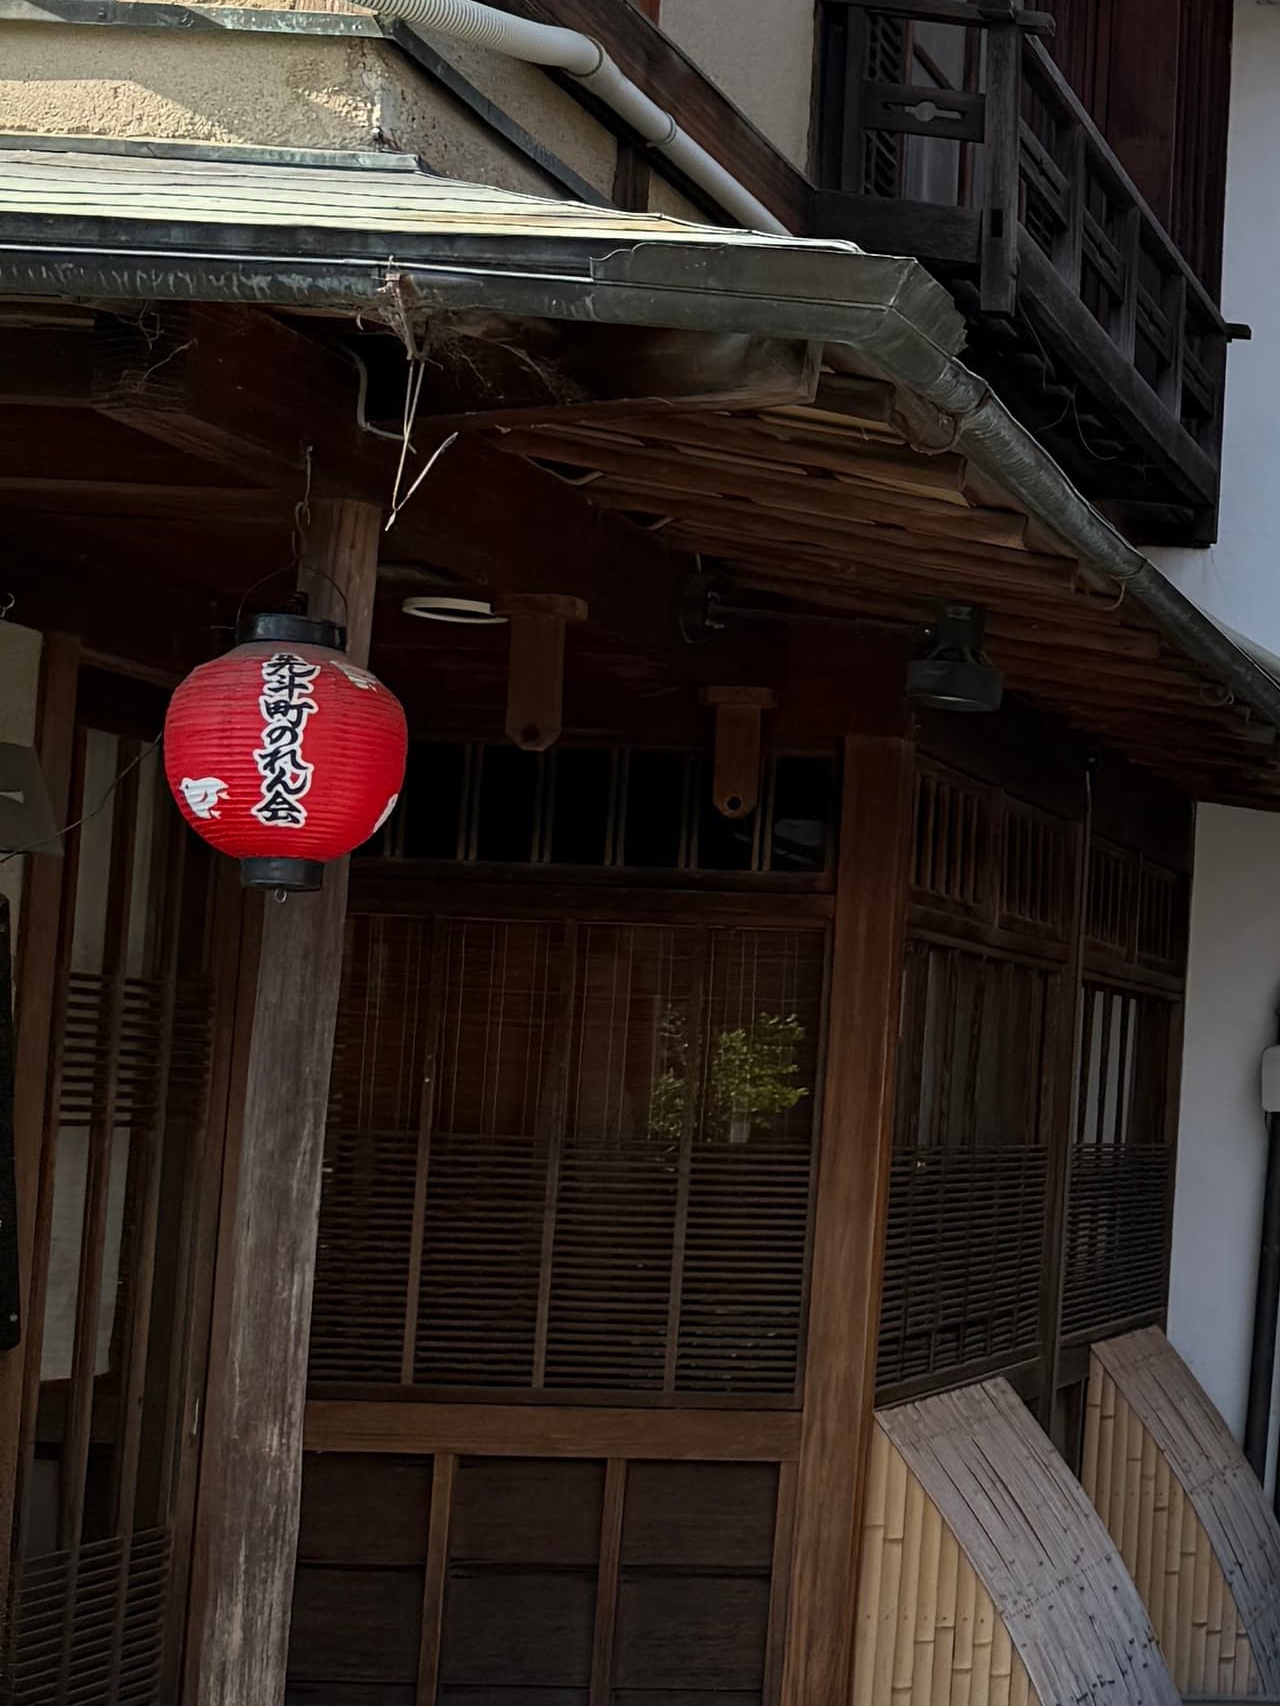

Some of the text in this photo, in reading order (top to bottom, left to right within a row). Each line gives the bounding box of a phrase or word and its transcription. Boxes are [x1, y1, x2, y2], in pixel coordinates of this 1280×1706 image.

[254, 653, 318, 826] 先斗町のれん会
